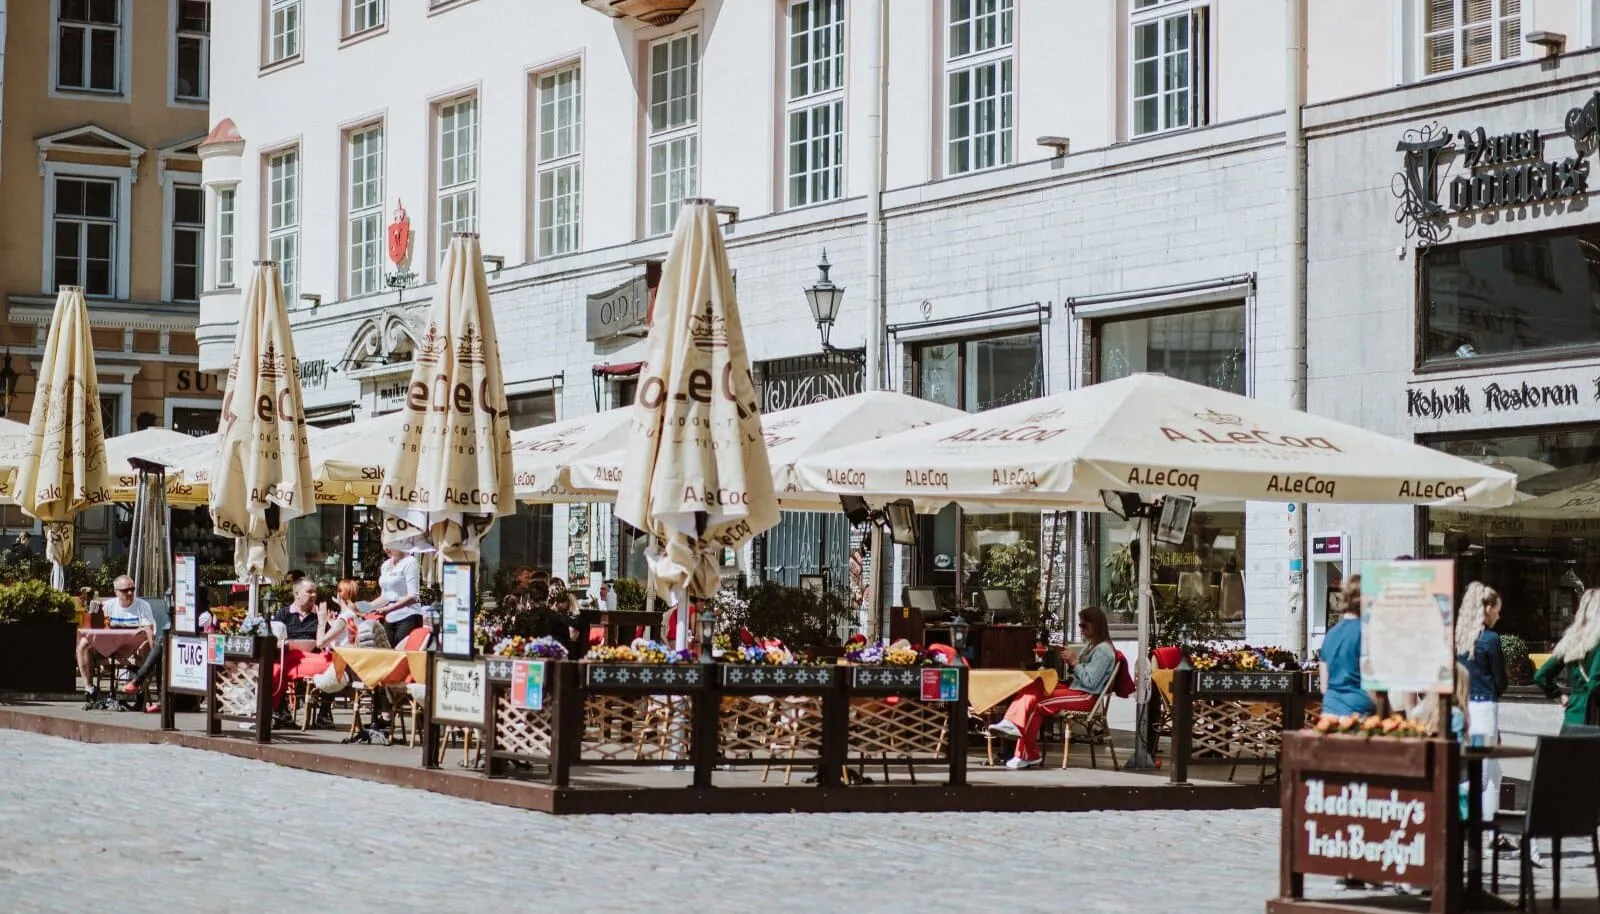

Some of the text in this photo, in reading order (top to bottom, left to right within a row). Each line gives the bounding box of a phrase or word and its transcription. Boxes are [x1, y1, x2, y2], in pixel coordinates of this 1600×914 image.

[1458, 126, 1541, 168] Vana
[1396, 128, 1589, 217] Toomas
[1406, 386, 1471, 419] Kohvik
[1483, 380, 1579, 412] Restoran
[1159, 426, 1343, 453] A.LeCoq
[594, 466, 624, 483] A.LeCo
[826, 468, 1039, 489] A.LeCoq A.LeCoq A.LeCoq
[1128, 467, 1468, 502] A.LeCoq A.LeCoq A.LeCoq
[177, 643, 203, 666] TURG
[1304, 820, 1349, 858] Irish
